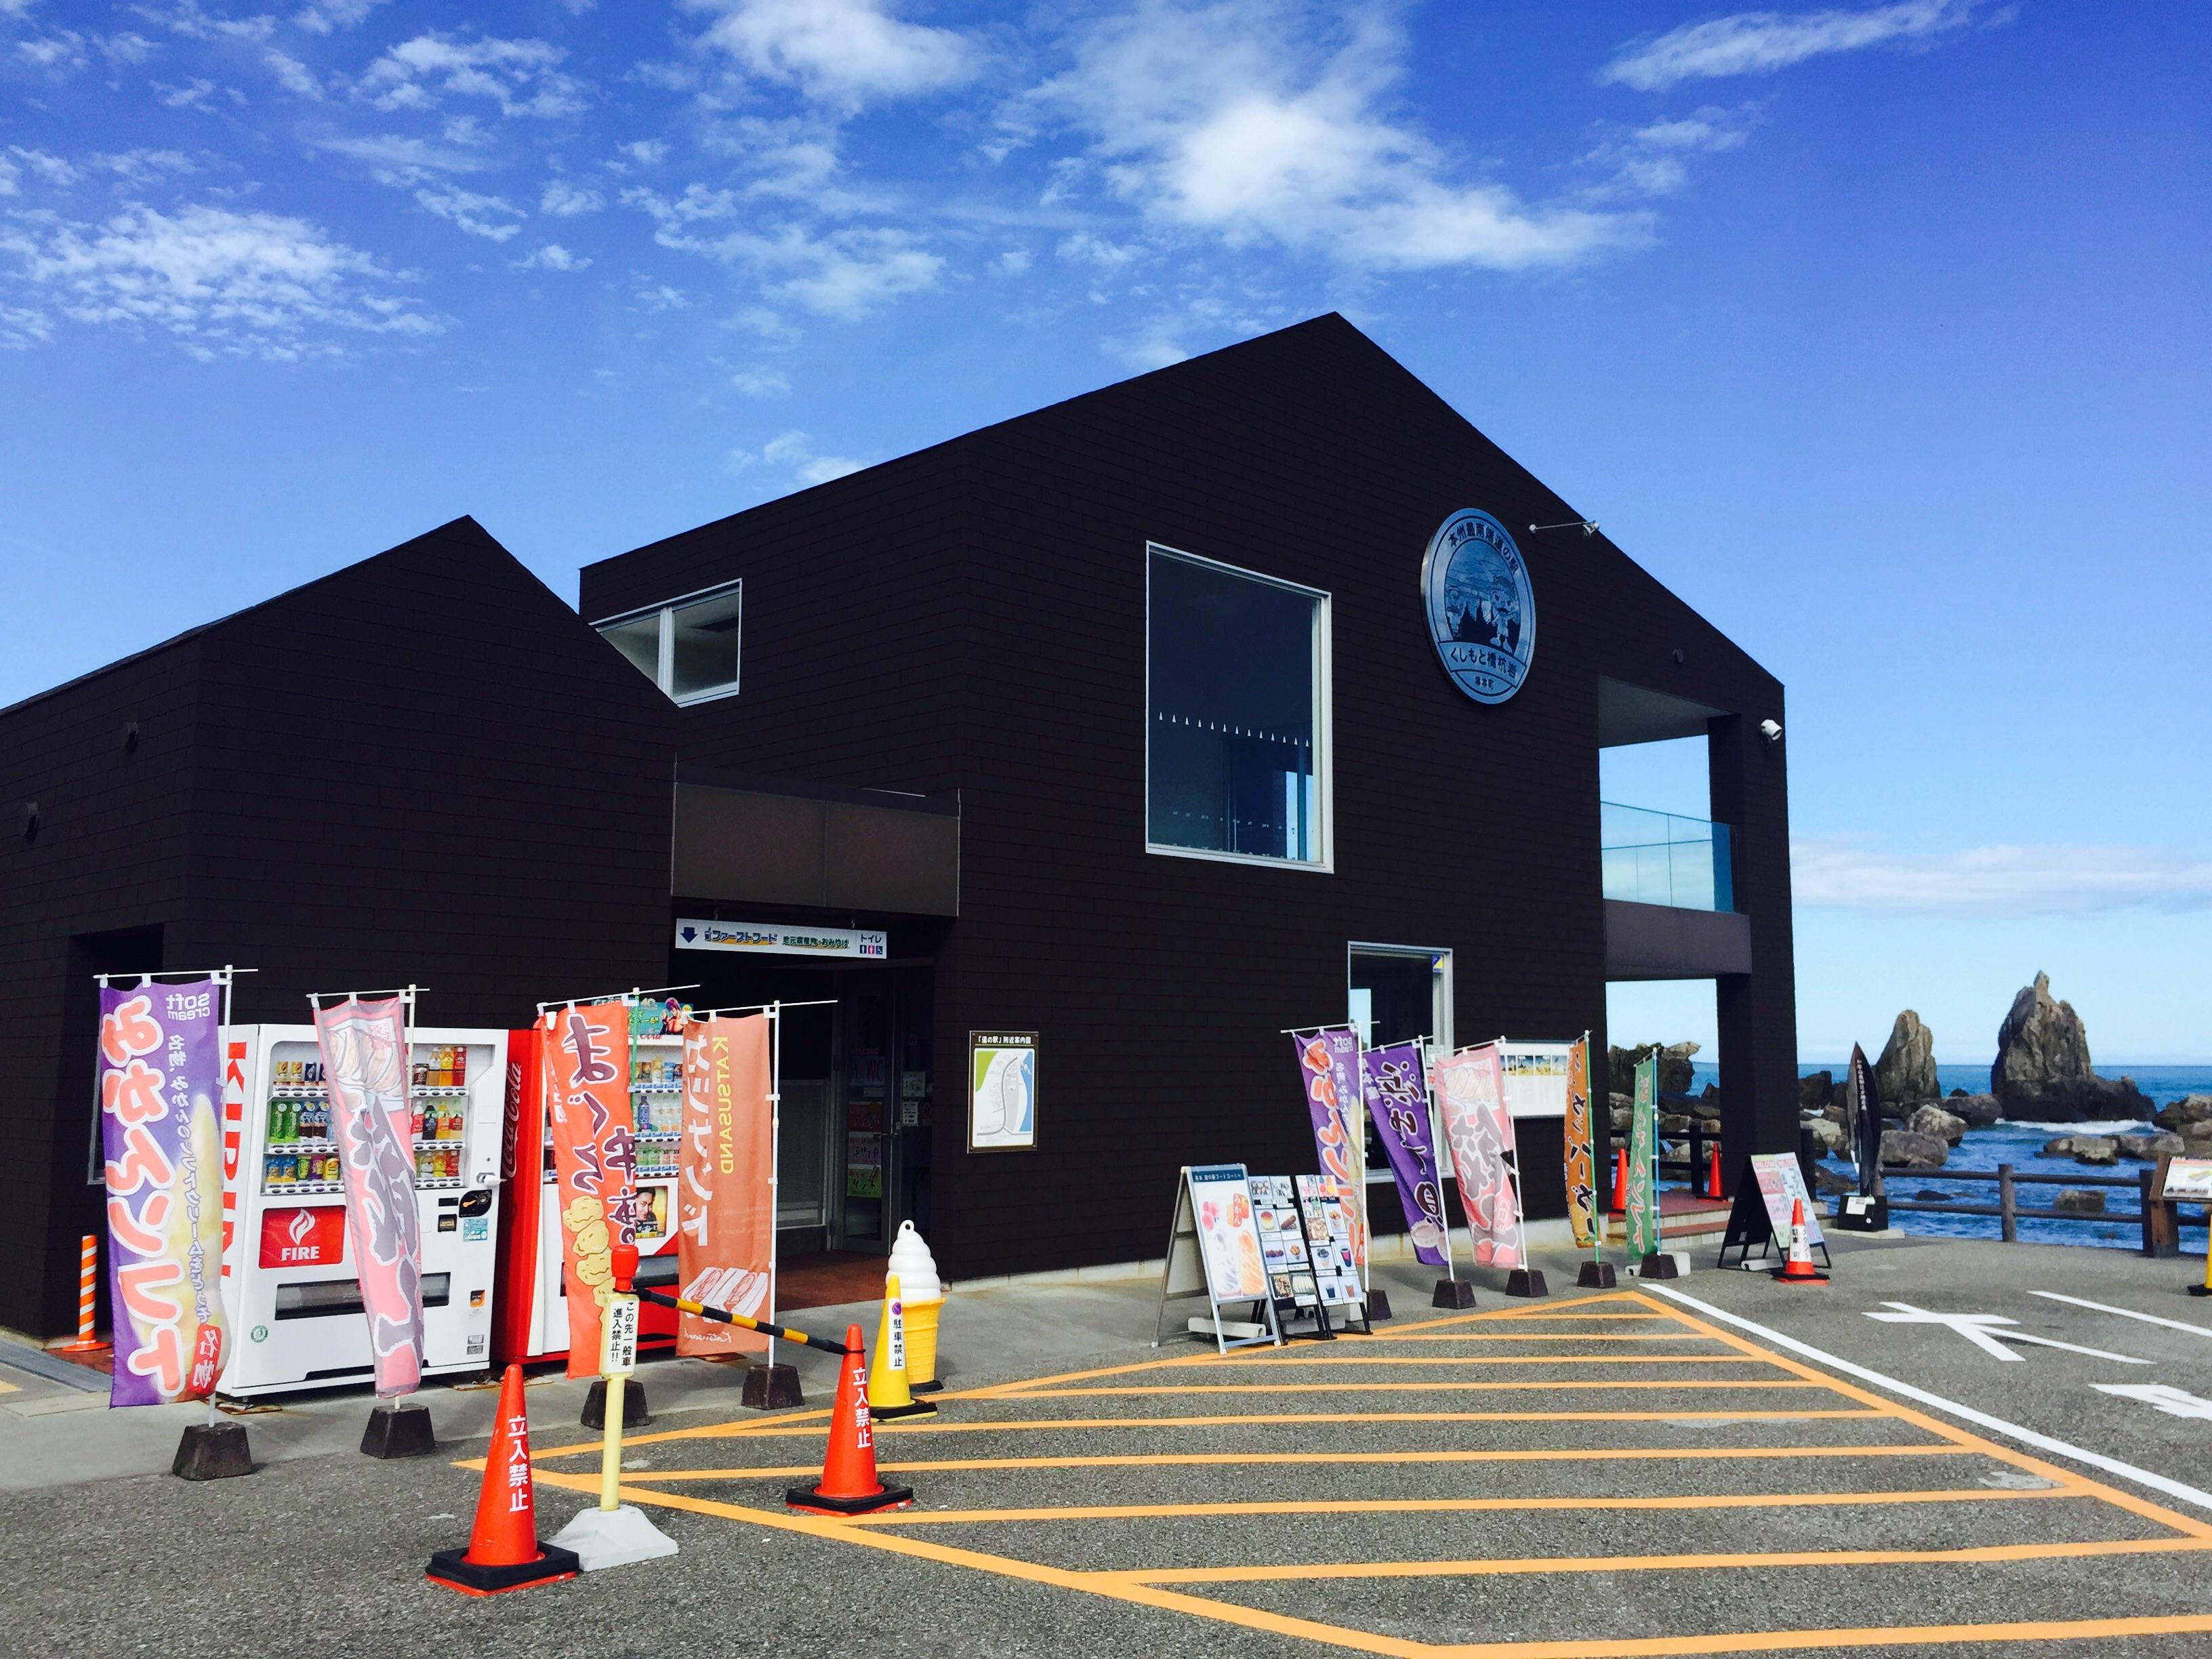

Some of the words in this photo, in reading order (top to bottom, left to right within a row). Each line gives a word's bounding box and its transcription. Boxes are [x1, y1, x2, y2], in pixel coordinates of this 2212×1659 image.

[1448, 522, 1519, 575] 本州最南端道の駅
[1450, 647, 1517, 678] くしもと橋杭岩
[712, 930, 777, 944] ファーストフード
[860, 934, 882, 943] トイレ
[281, 1246, 320, 1261] FIRE
[621, 1302, 634, 1367] この先一般車
[893, 1319, 903, 1367] 駐車禁止
[853, 1366, 872, 1449] 立入禁止
[508, 1414, 529, 1513] 立入禁止
